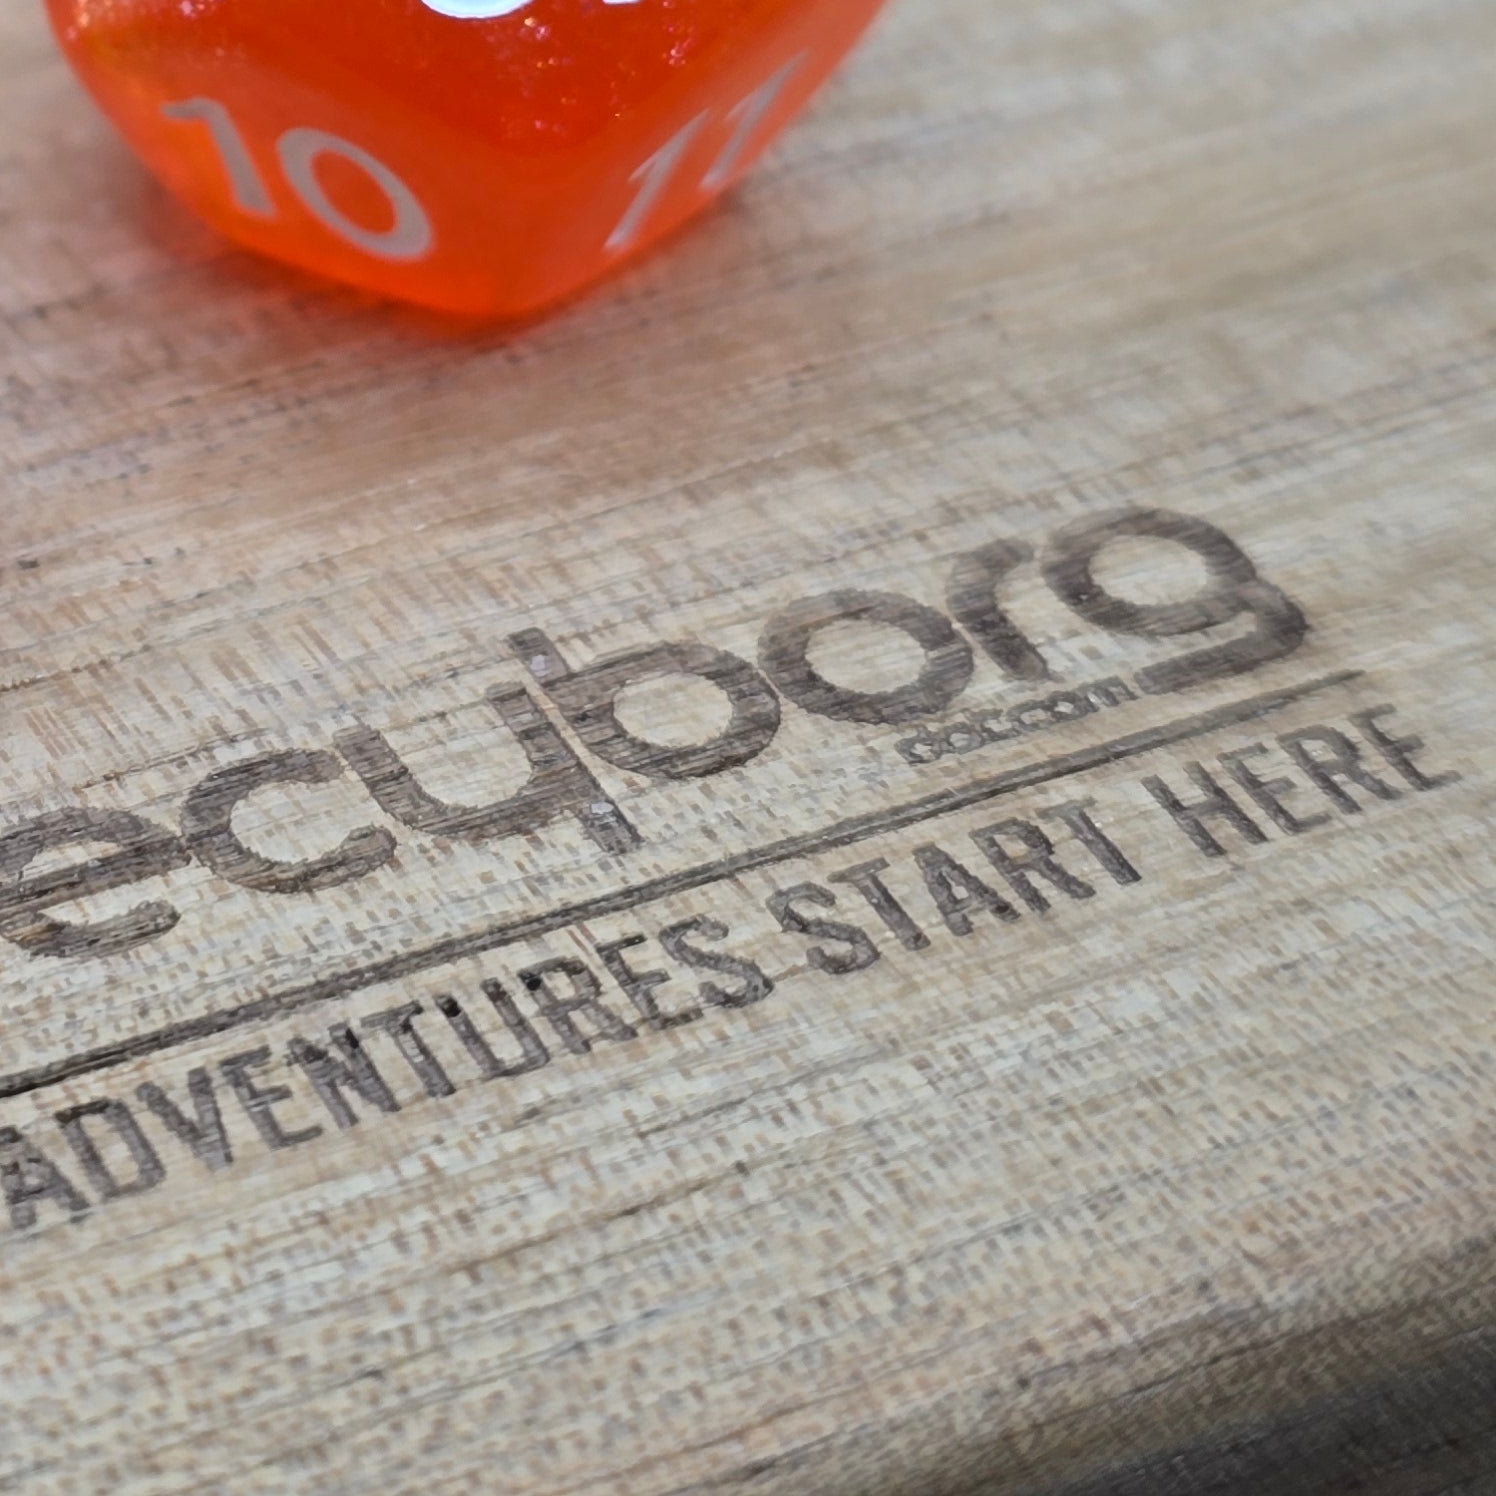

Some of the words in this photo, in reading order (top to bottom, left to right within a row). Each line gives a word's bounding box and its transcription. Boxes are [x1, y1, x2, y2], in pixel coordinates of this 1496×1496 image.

[162, 96, 434, 261] 10
[601, 49, 809, 252] 11
[766, 798, 1144, 977] START
[1140, 702, 1463, 860] HERE
